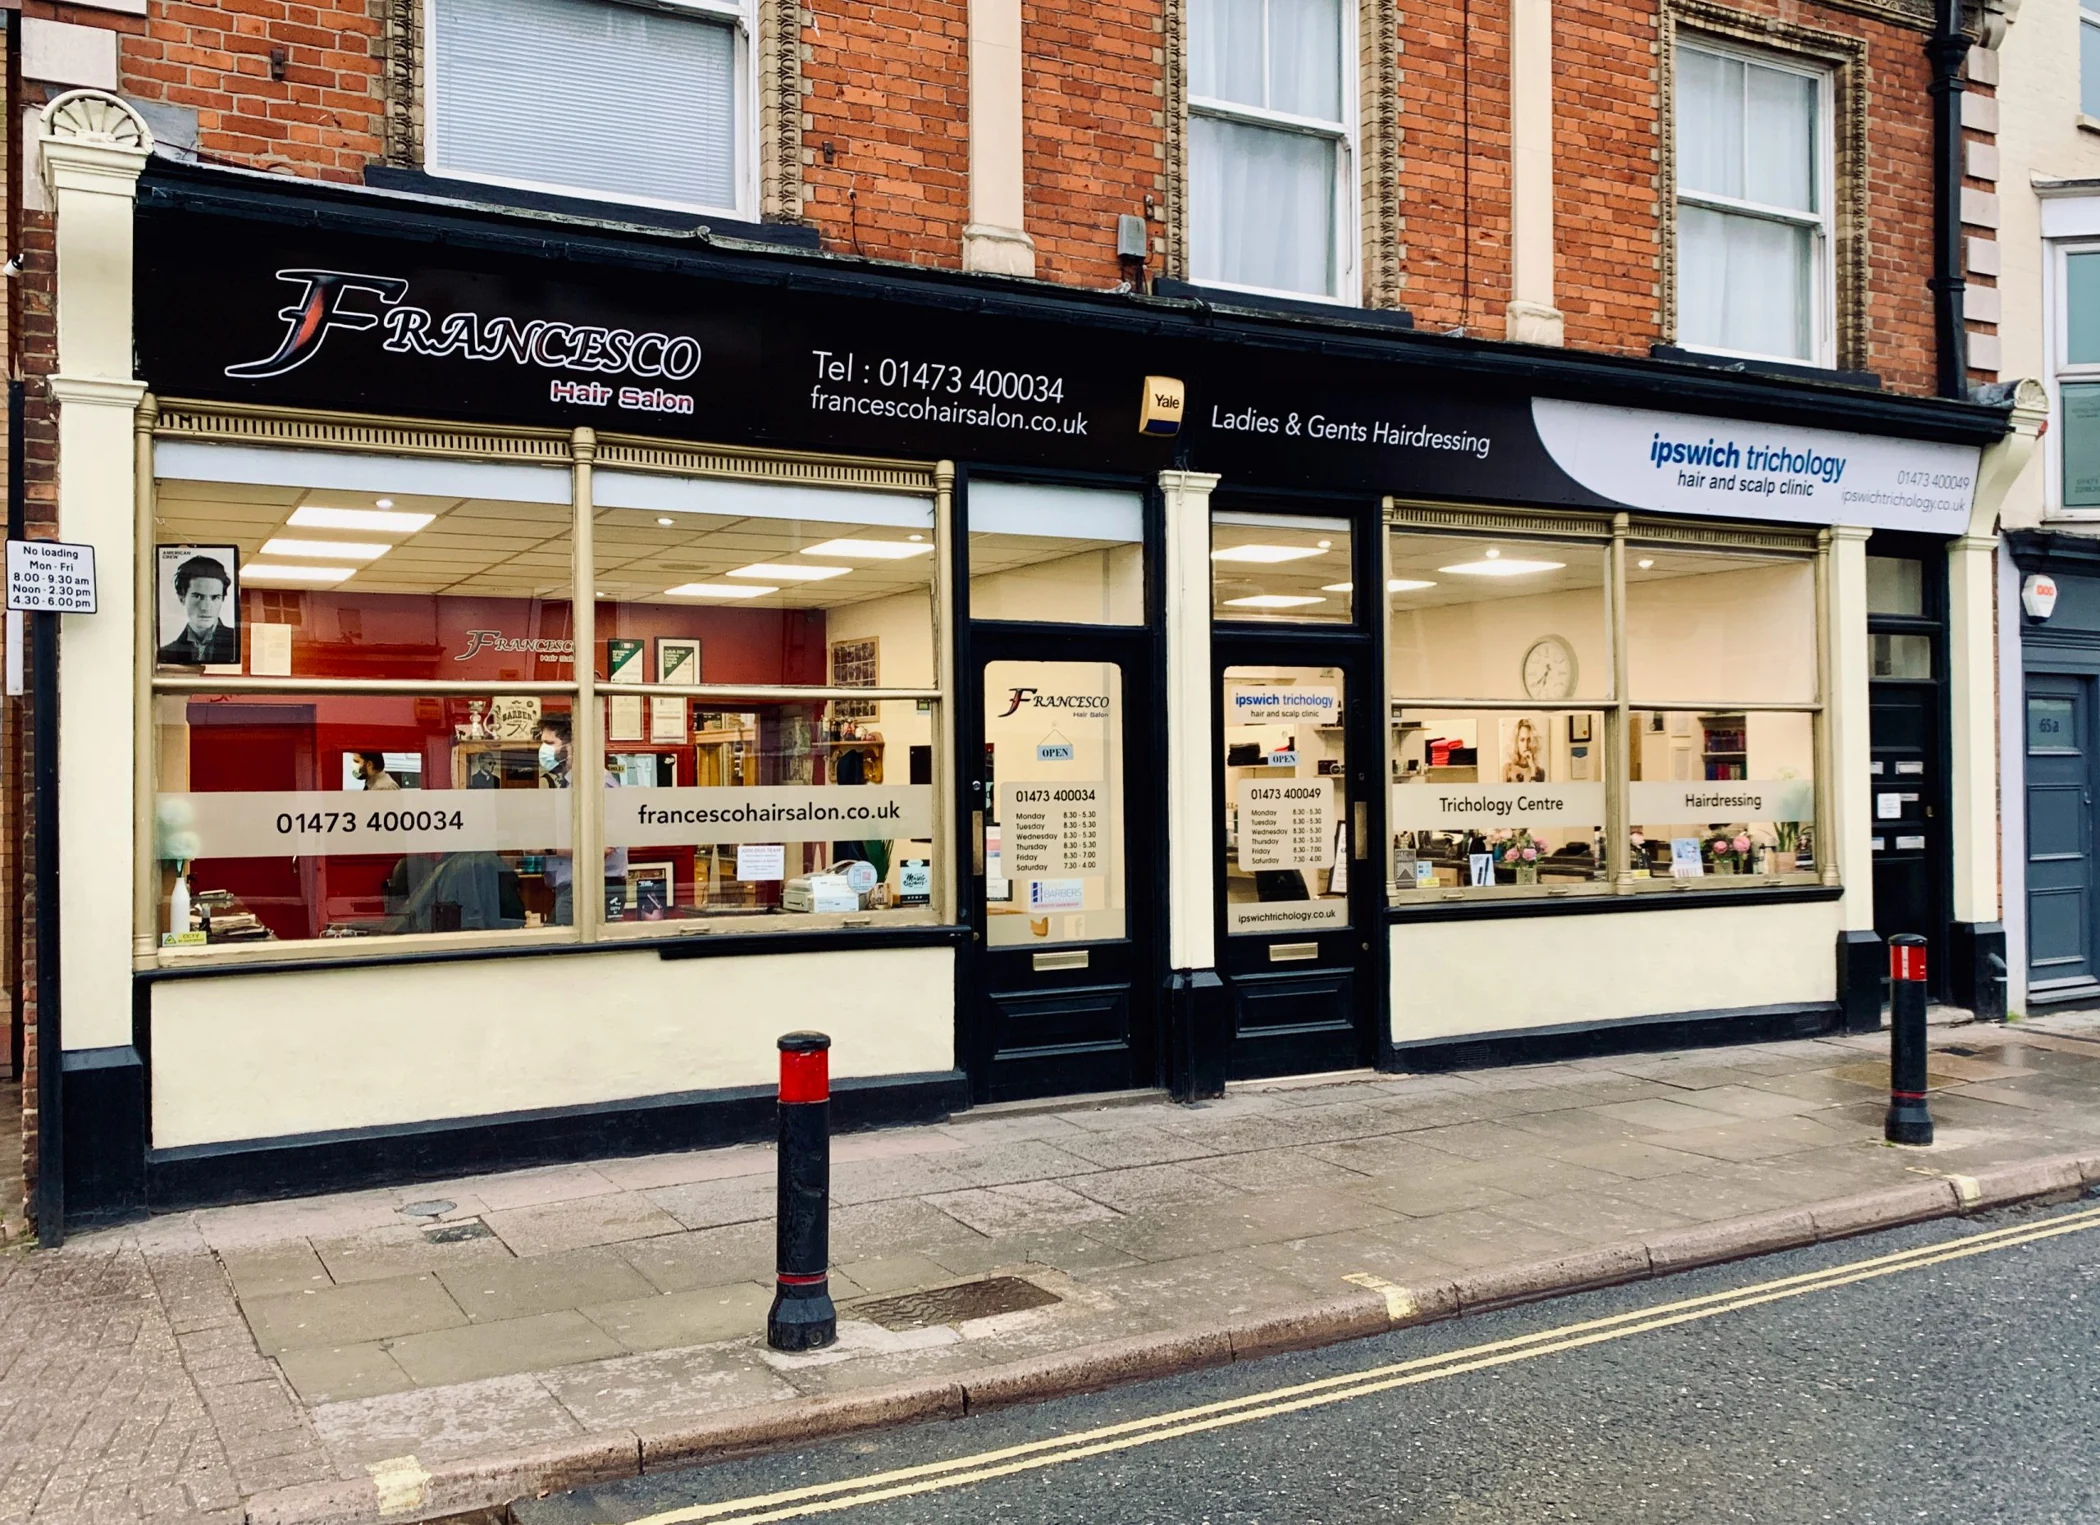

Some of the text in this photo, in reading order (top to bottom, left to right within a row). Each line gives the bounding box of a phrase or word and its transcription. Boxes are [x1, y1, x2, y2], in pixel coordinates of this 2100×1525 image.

[225, 269, 701, 380] FRANCESCO
[812, 350, 1064, 404] Tel : 01473 400034
[550, 380, 694, 415] Hair Salon
[1154, 393, 1180, 409] Yale
[810, 385, 1089, 435] francescohairsalon.co.uk
[1211, 404, 1490, 459] Ladies & Gents Hairdressing
[1650, 432, 1846, 484] ipswich trichology
[1677, 470, 1815, 498] hair and scalp clinic
[1897, 470, 1970, 491] 01473 400049
[1840, 487, 1966, 513] ipswichtrichology.co.uk
[23, 546, 79, 560] No loading
[30, 560, 51, 571] Mon
[60, 561, 74, 572] Fri
[13, 572, 40, 583] 8.00
[48, 574, 73, 585] 9.30
[74, 577, 90, 586] am
[12, 584, 41, 594] Noon
[49, 586, 73, 596] 2.30
[75, 588, 91, 598] pm
[13, 595, 40, 605] 4.30
[47, 597, 73, 608] 6.00
[75, 599, 91, 609] pm
[454, 630, 574, 661] FRANCESC
[997, 687, 1110, 718] FRANCESCO
[1235, 693, 1334, 708] ipswich trichology
[1281, 710, 1300, 718] scalp
[1042, 747, 1069, 757] OPEN
[1272, 754, 1295, 763] OPEN
[1016, 789, 1096, 802] 01473 400034
[1251, 788, 1321, 800] 01473 400049
[1685, 792, 1761, 810] Hairdressing
[638, 800, 900, 824] francescohairsalon.co.uk
[1439, 796, 1564, 815] Trichology Centre
[276, 810, 464, 834] 01473 400034
[1063, 811, 1077, 819] 8.30
[1016, 823, 1046, 831] Tuesday
[1063, 821, 1077, 829] 8.30
[1016, 833, 1058, 841] Wednesday
[1016, 843, 1048, 851] Thursday
[1238, 909, 1336, 924] ipswichtrichology.co.uk
